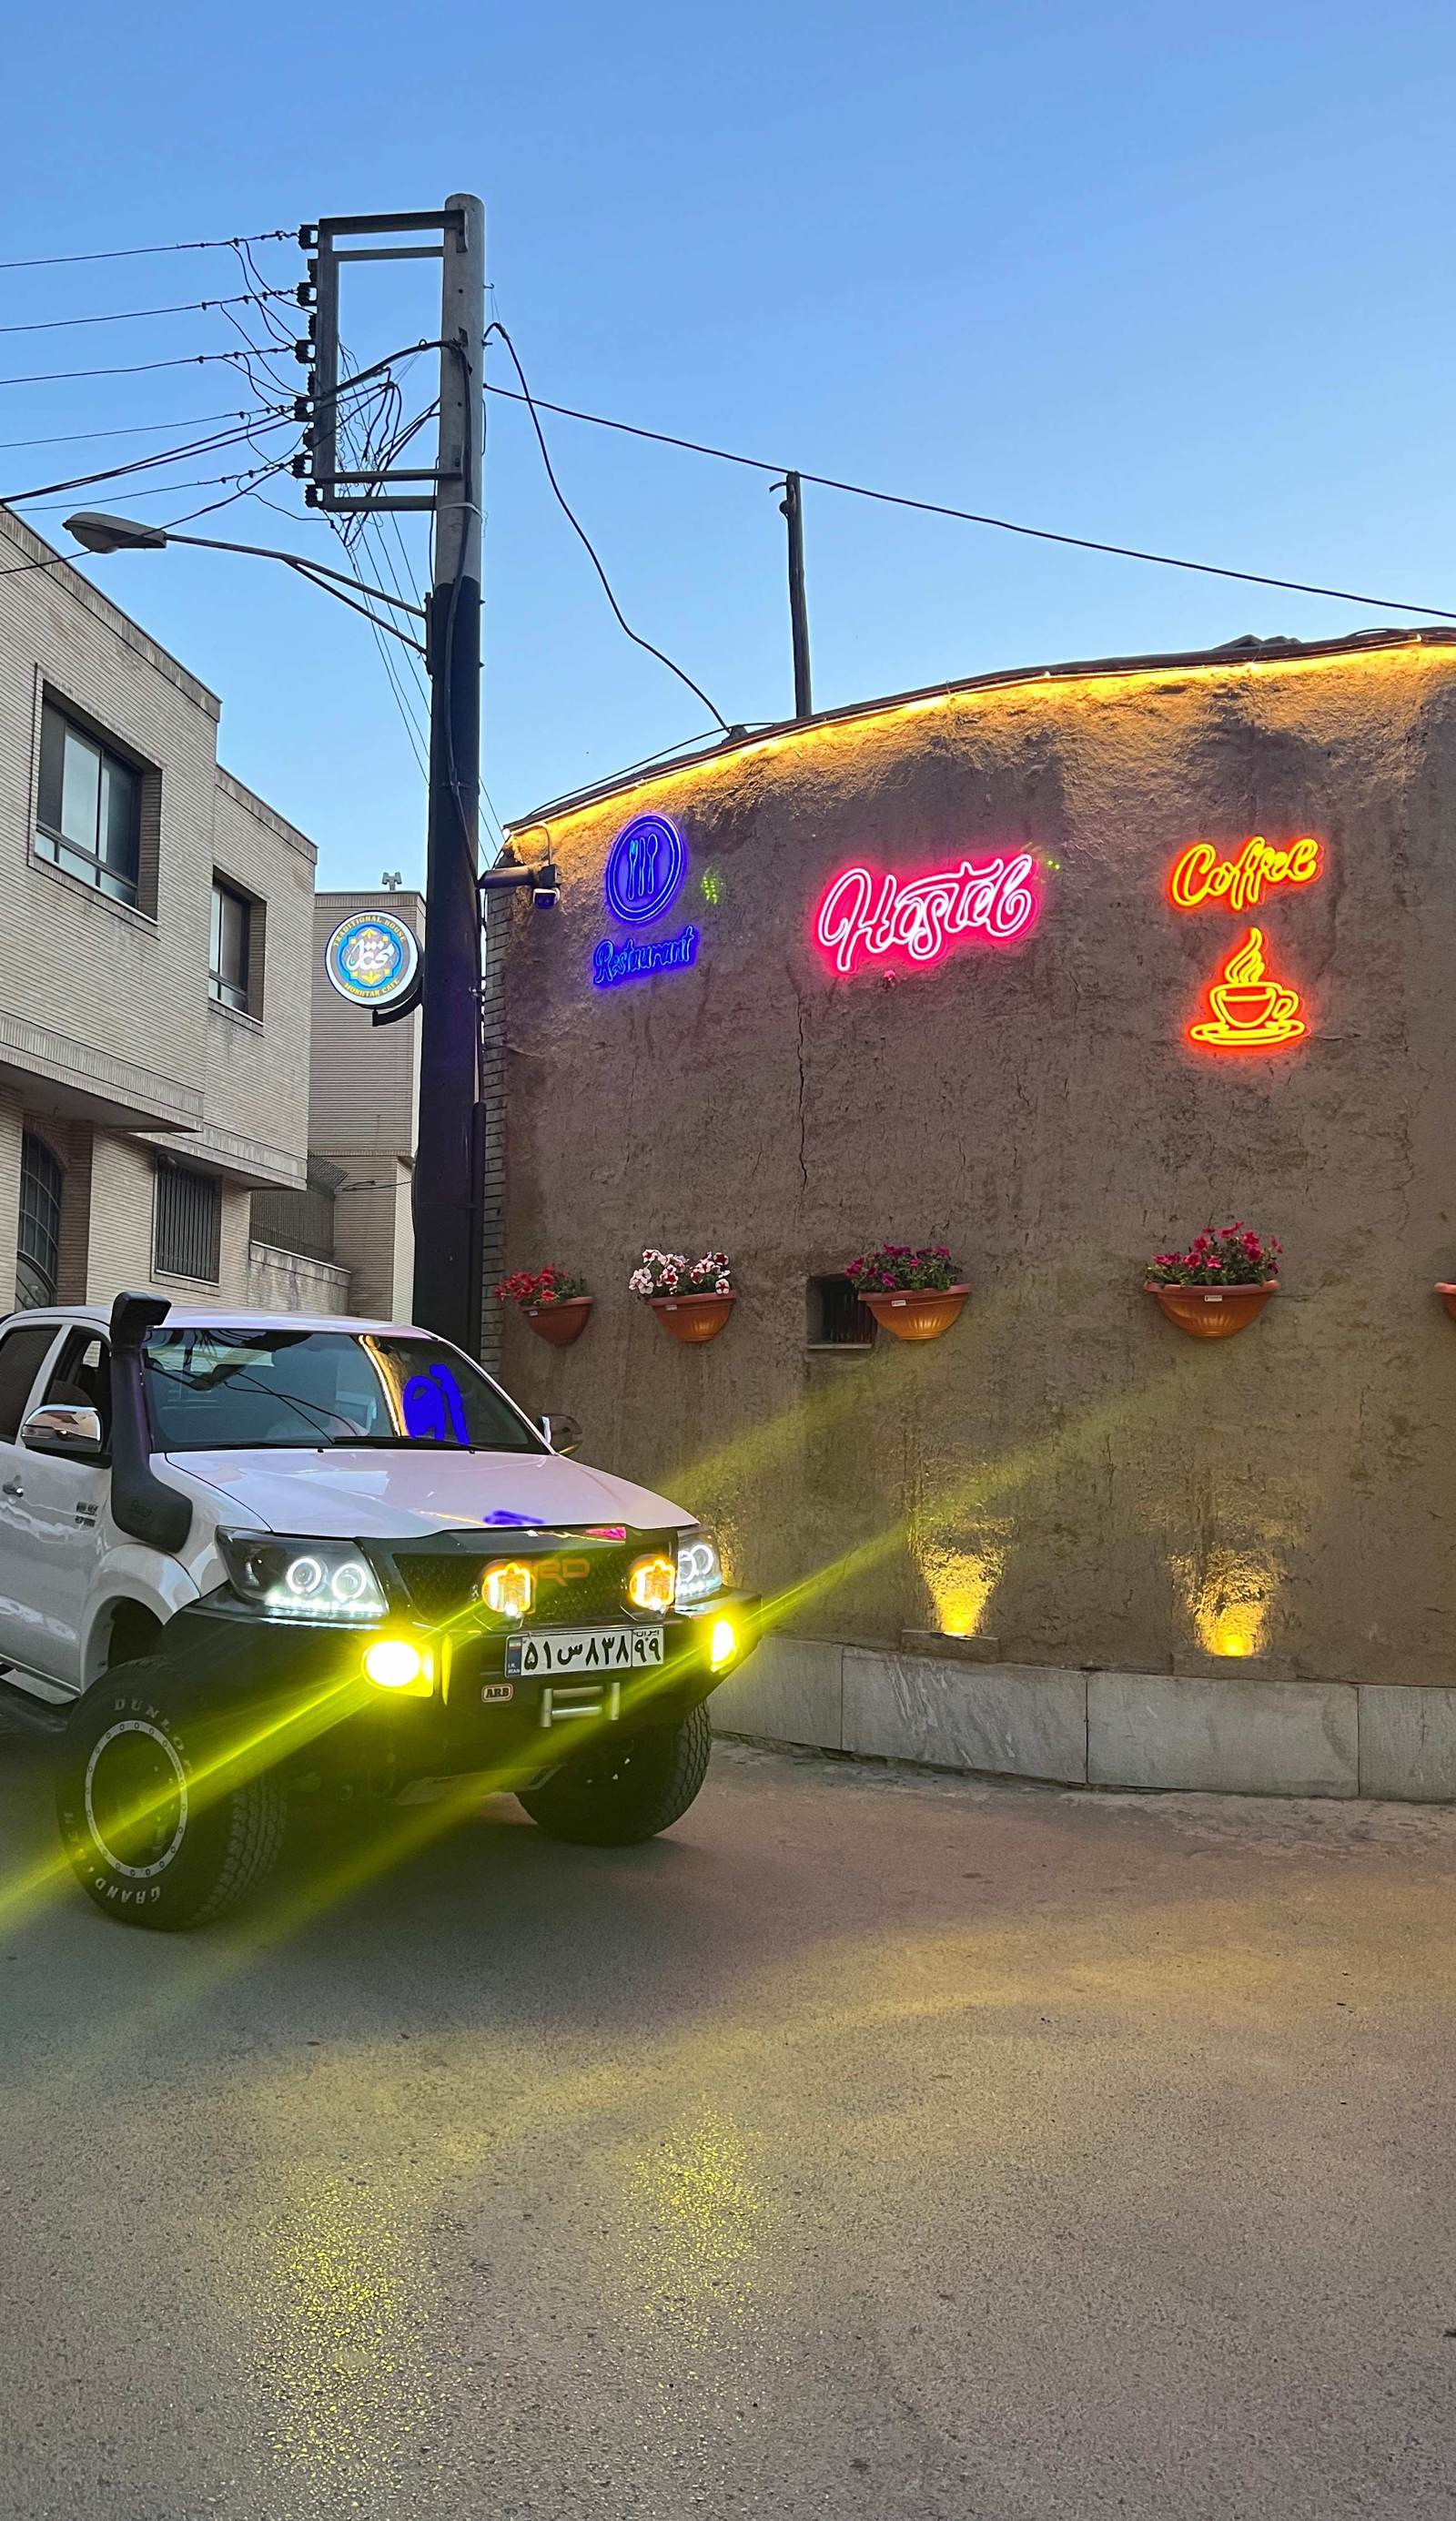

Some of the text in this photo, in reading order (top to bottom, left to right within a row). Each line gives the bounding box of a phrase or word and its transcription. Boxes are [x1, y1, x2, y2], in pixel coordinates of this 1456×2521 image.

[1172, 835, 1320, 910] Coffee
[818, 854, 1033, 971] Hostel
[594, 925, 695, 984] Restaurant
[484, 1686, 510, 1699] ARB
